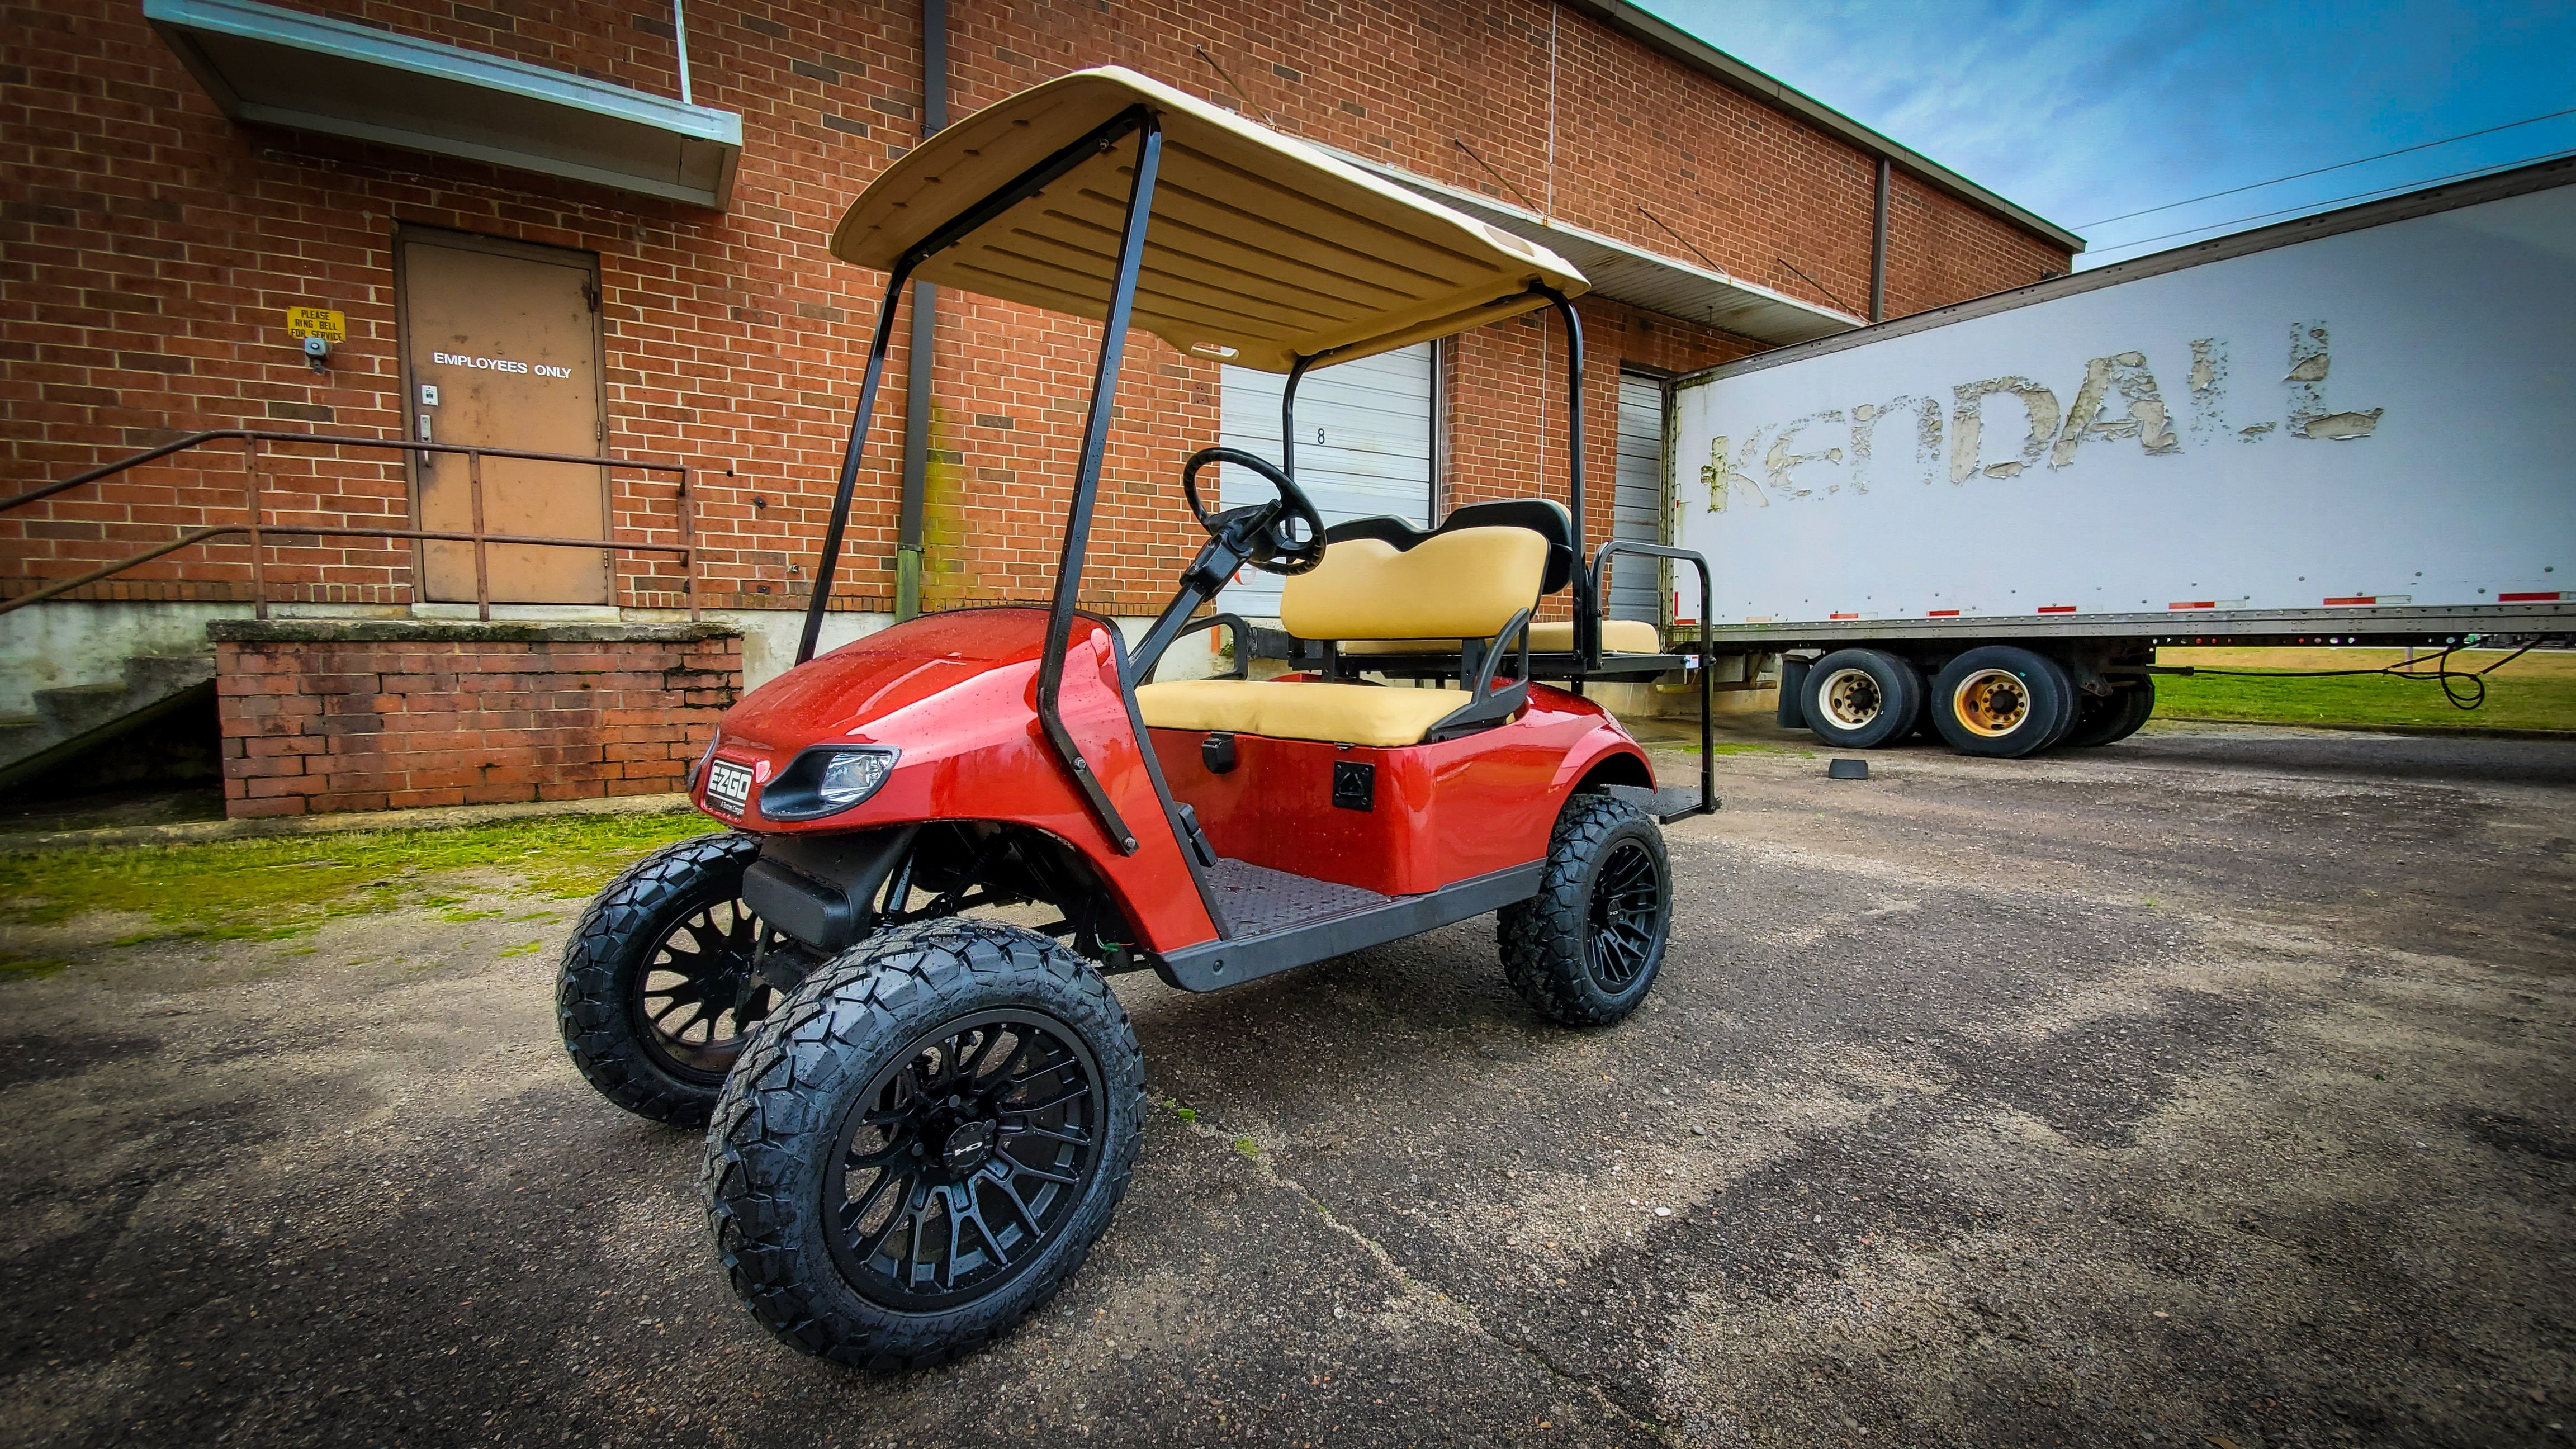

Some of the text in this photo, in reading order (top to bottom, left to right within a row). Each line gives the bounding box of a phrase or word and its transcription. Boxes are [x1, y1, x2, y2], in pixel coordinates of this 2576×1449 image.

[301, 309, 330, 320] PLEASE
[295, 319, 338, 331] RING BELL
[291, 328, 342, 341] FOR SERVICE
[434, 352, 572, 378] EMPLOYEES ONLY
[1317, 428, 1325, 444] 8
[955, 1141, 983, 1157] HD
